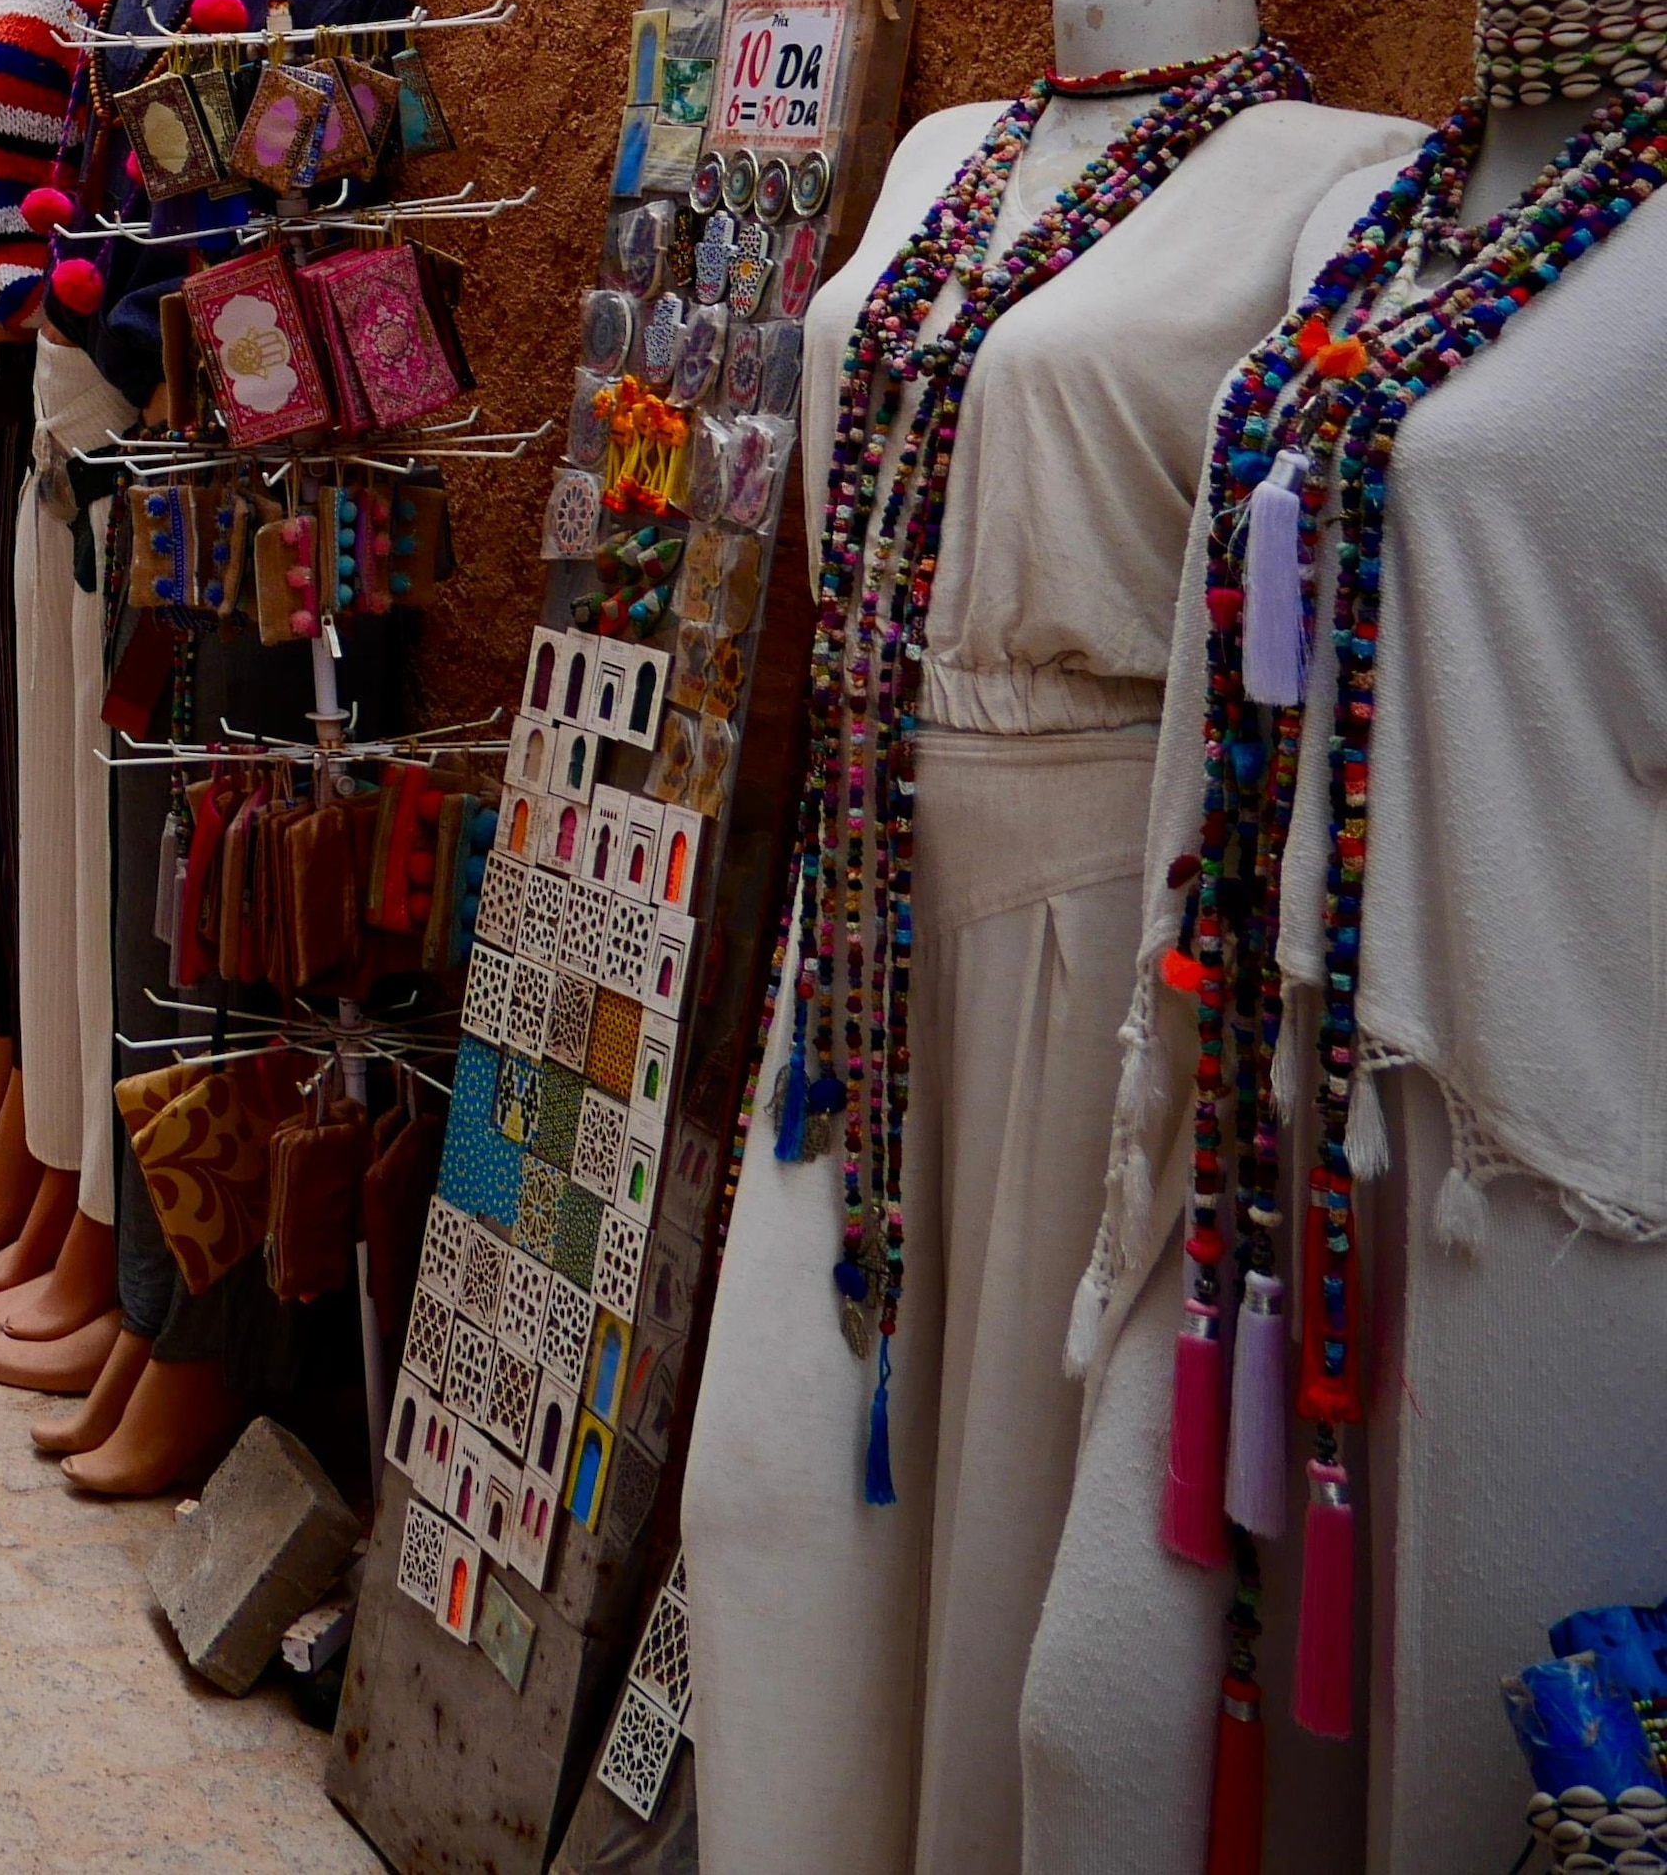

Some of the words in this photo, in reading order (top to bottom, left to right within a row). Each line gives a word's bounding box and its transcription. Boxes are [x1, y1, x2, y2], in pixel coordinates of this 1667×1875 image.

[771, 12, 789, 27] Prix
[733, 29, 772, 89] 10
[775, 43, 823, 90] Dh
